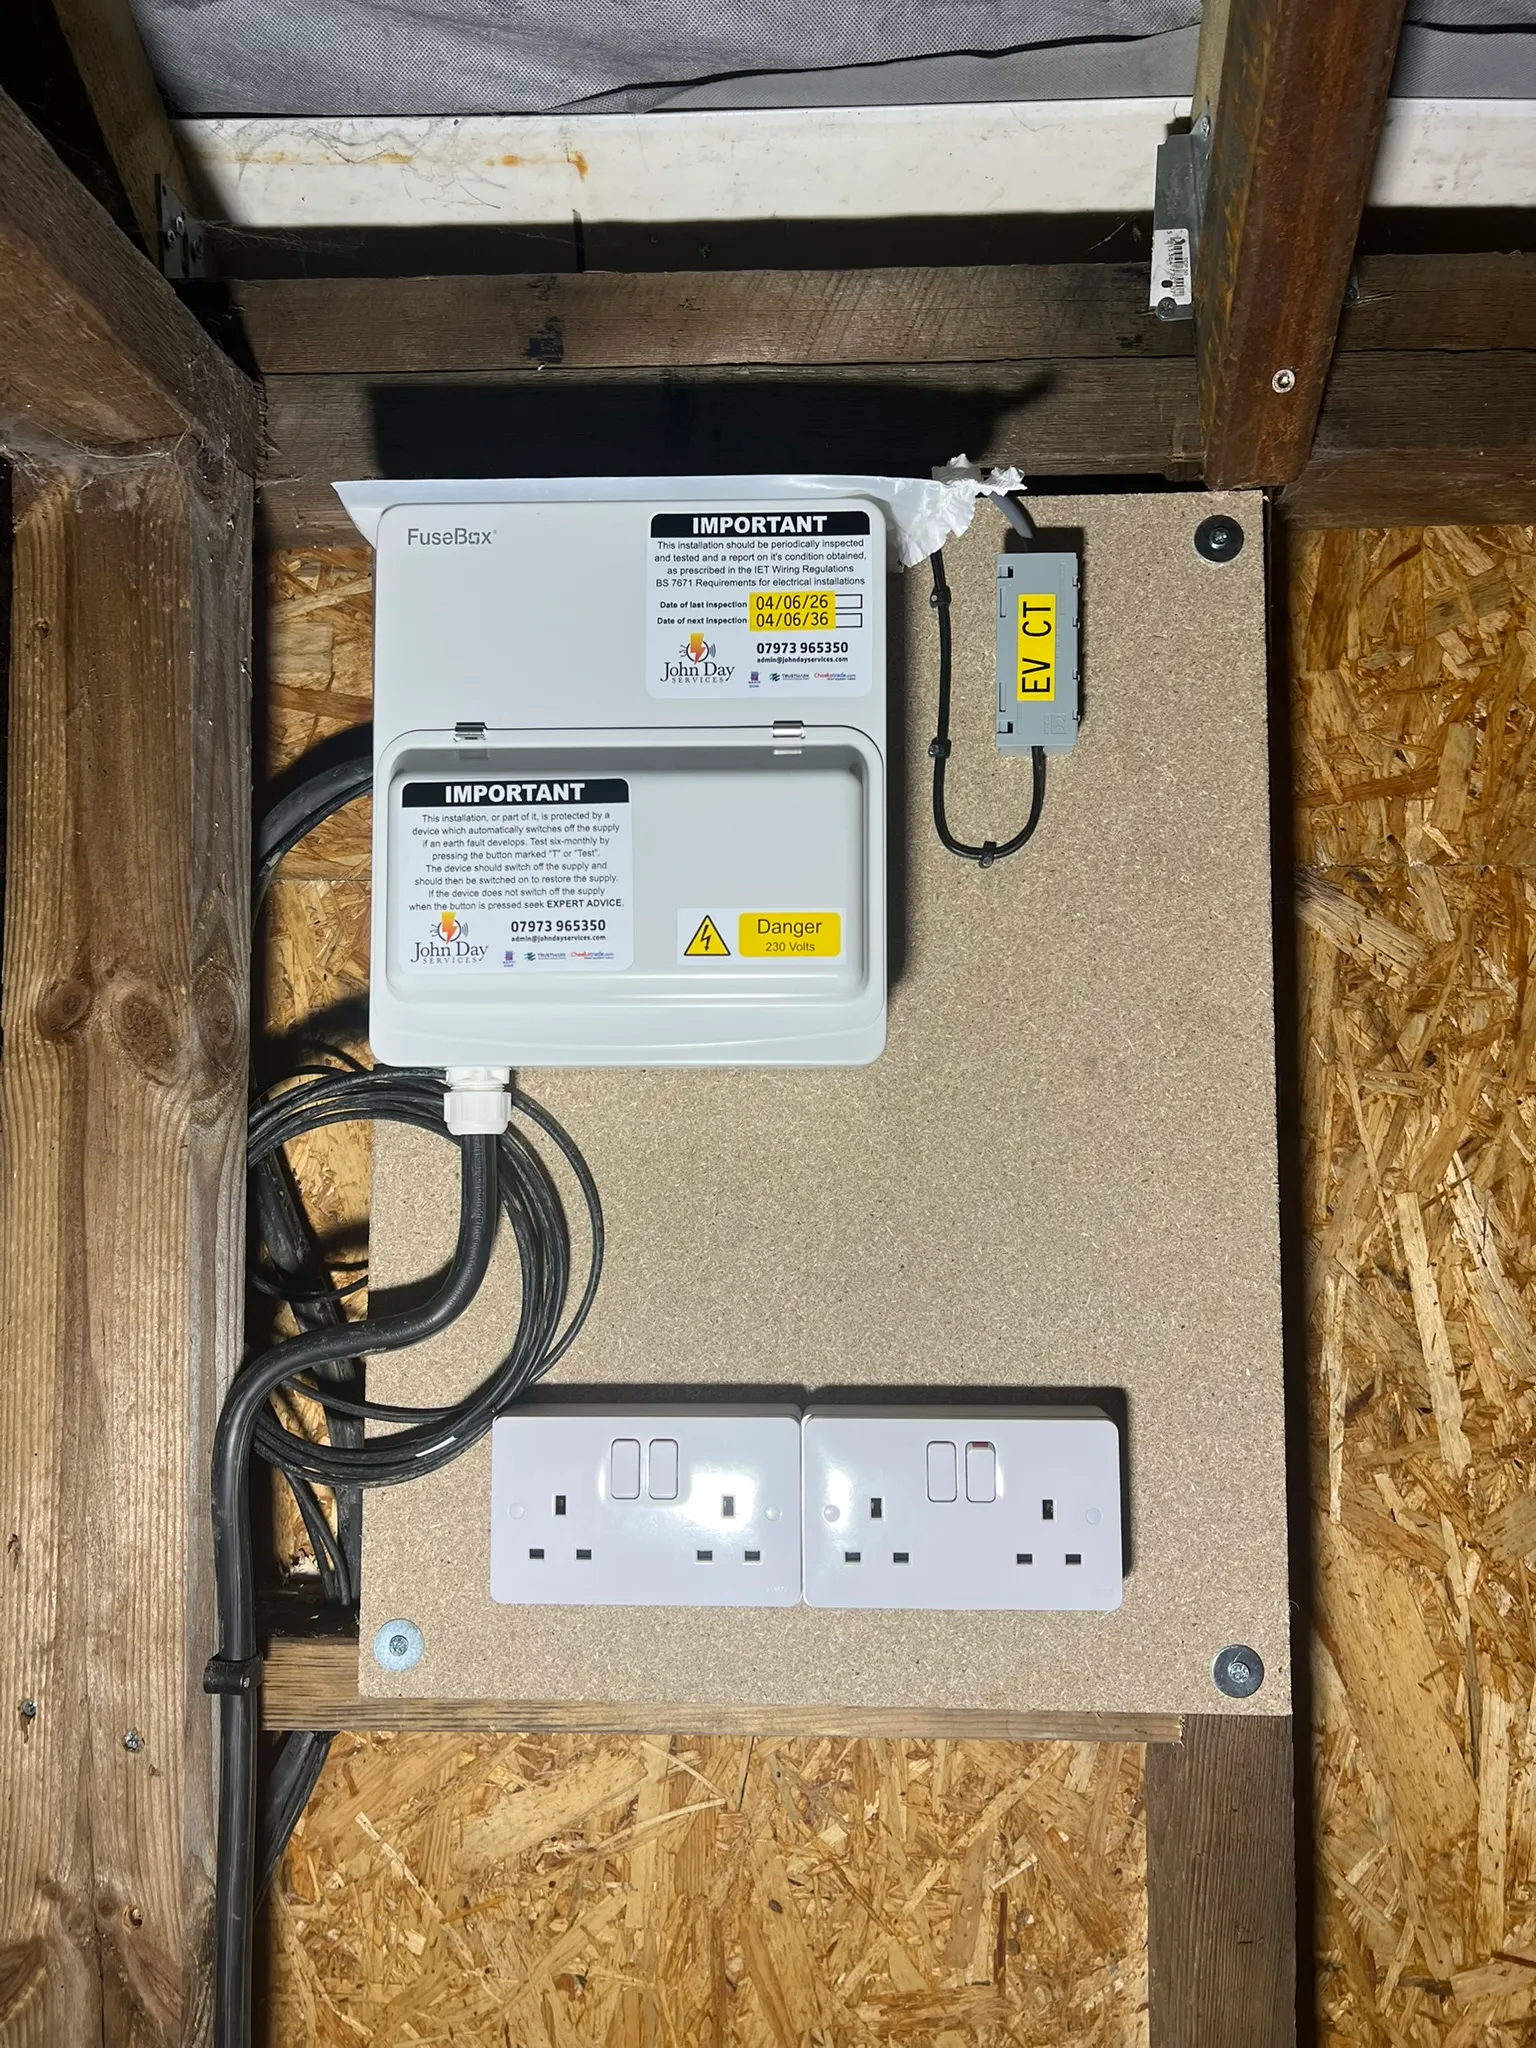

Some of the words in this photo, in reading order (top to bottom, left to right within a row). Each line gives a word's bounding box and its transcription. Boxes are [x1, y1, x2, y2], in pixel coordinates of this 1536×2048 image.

[692, 515, 828, 534] IMPORTANT
[407, 527, 492, 545] FuseBox
[657, 540, 676, 550] This
[677, 540, 724, 550] installation
[726, 540, 755, 549] should
[757, 540, 769, 549] be
[770, 539, 820, 550] periodically
[822, 538, 864, 549] inspected
[654, 553, 671, 562] and
[672, 553, 700, 562] tested
[701, 553, 719, 562] and
[720, 554, 727, 562] a
[728, 553, 755, 563] report
[770, 552, 783, 561] it's
[784, 552, 824, 561] condition
[825, 551, 867, 560] obtained,
[666, 567, 678, 575] as
[679, 565, 726, 576] prescribed
[727, 566, 736, 574] in
[737, 565, 752, 574] the
[754, 565, 770, 574] IET
[771, 564, 800, 576] Wiring
[802, 564, 854, 575] Regulations
[655, 578, 669, 587] BS
[671, 578, 692, 587] 7671
[695, 578, 757, 588] Requirements
[758, 577, 771, 586] for
[772, 577, 812, 586] electrical
[813, 576, 865, 586] installations
[659, 601, 678, 609] Date
[679, 600, 688, 608] of
[705, 600, 748, 610] inspection
[756, 593, 828, 610] 04/06/26
[676, 616, 686, 625] of
[705, 616, 748, 625] inspection
[756, 611, 829, 628] 04/06/36
[1022, 601, 1052, 637] CT
[756, 642, 797, 654] 07973
[800, 641, 848, 654] 965350
[756, 656, 848, 664] admin@johndayservices.com
[660, 661, 700, 683] John
[703, 661, 735, 682] Day
[1022, 657, 1051, 693] EV
[671, 676, 724, 684] SERVICES
[445, 782, 585, 803] IMPORTANT
[422, 814, 440, 823] This
[441, 813, 489, 822] installation,
[490, 814, 500, 822] or
[502, 813, 519, 823] part
[520, 812, 530, 821] of
[531, 812, 539, 822] it,
[541, 812, 549, 820] is
[550, 810, 590, 822] protected
[591, 811, 603, 821] by
[604, 811, 610, 819] a
[411, 827, 440, 836] device
[441, 826, 466, 835] which
[468, 825, 524, 835] automatically
[525, 824, 562, 834] switches
[563, 823, 575, 833] off
[576, 824, 590, 832] the
[592, 823, 620, 833] supply
[422, 839, 428, 848] if
[429, 840, 441, 848] an
[442, 839, 465, 848] earth
[466, 838, 485, 847] fault
[486, 838, 527, 848] develops.
[529, 837, 548, 846] Test
[549, 836, 598, 846] six-monthly
[599, 836, 610, 846] by
[432, 851, 468, 862] pressing
[469, 851, 484, 860] the
[485, 851, 513, 859] button
[514, 849, 546, 859] marked
[548, 849, 561, 857] "T"
[562, 850, 572, 858] or
[573, 848, 600, 857] "Test".
[425, 864, 442, 873] The
[443, 864, 472, 873] device
[473, 863, 502, 872] should
[504, 862, 531, 872] switch
[532, 862, 544, 871] off
[545, 862, 559, 871] the
[561, 861, 589, 872] supply
[590, 861, 607, 870] and
[414, 876, 443, 886] should
[444, 877, 464, 885] then
[465, 876, 477, 885] be
[478, 875, 516, 885] switched
[517, 876, 529, 884] on
[531, 875, 540, 884] to
[541, 875, 571, 883] restore
[573, 874, 587, 883] the
[588, 873, 618, 884] supply.
[428, 889, 434, 898] If
[435, 889, 450, 898] the
[451, 889, 479, 898] device
[481, 888, 503, 897] does
[504, 888, 518, 897] not
[520, 887, 547, 896] switch
[548, 887, 560, 896] off
[561, 887, 575, 895] the
[577, 886, 605, 897] supply
[408, 902, 432, 911] when
[433, 902, 447, 910] the
[449, 902, 476, 910] button
[478, 902, 486, 910] is
[487, 900, 521, 911] pressed
[523, 900, 544, 909] seek
[546, 899, 585, 908] EXPERT
[585, 898, 624, 907] ADVICE.
[510, 920, 552, 933] 07973
[555, 919, 606, 932] 965350
[757, 918, 823, 938] Danger
[511, 934, 606, 943] admin@johndayservices.com
[410, 941, 451, 963] John
[455, 940, 489, 962] Day
[765, 941, 786, 952] 230
[788, 941, 815, 952] Volts
